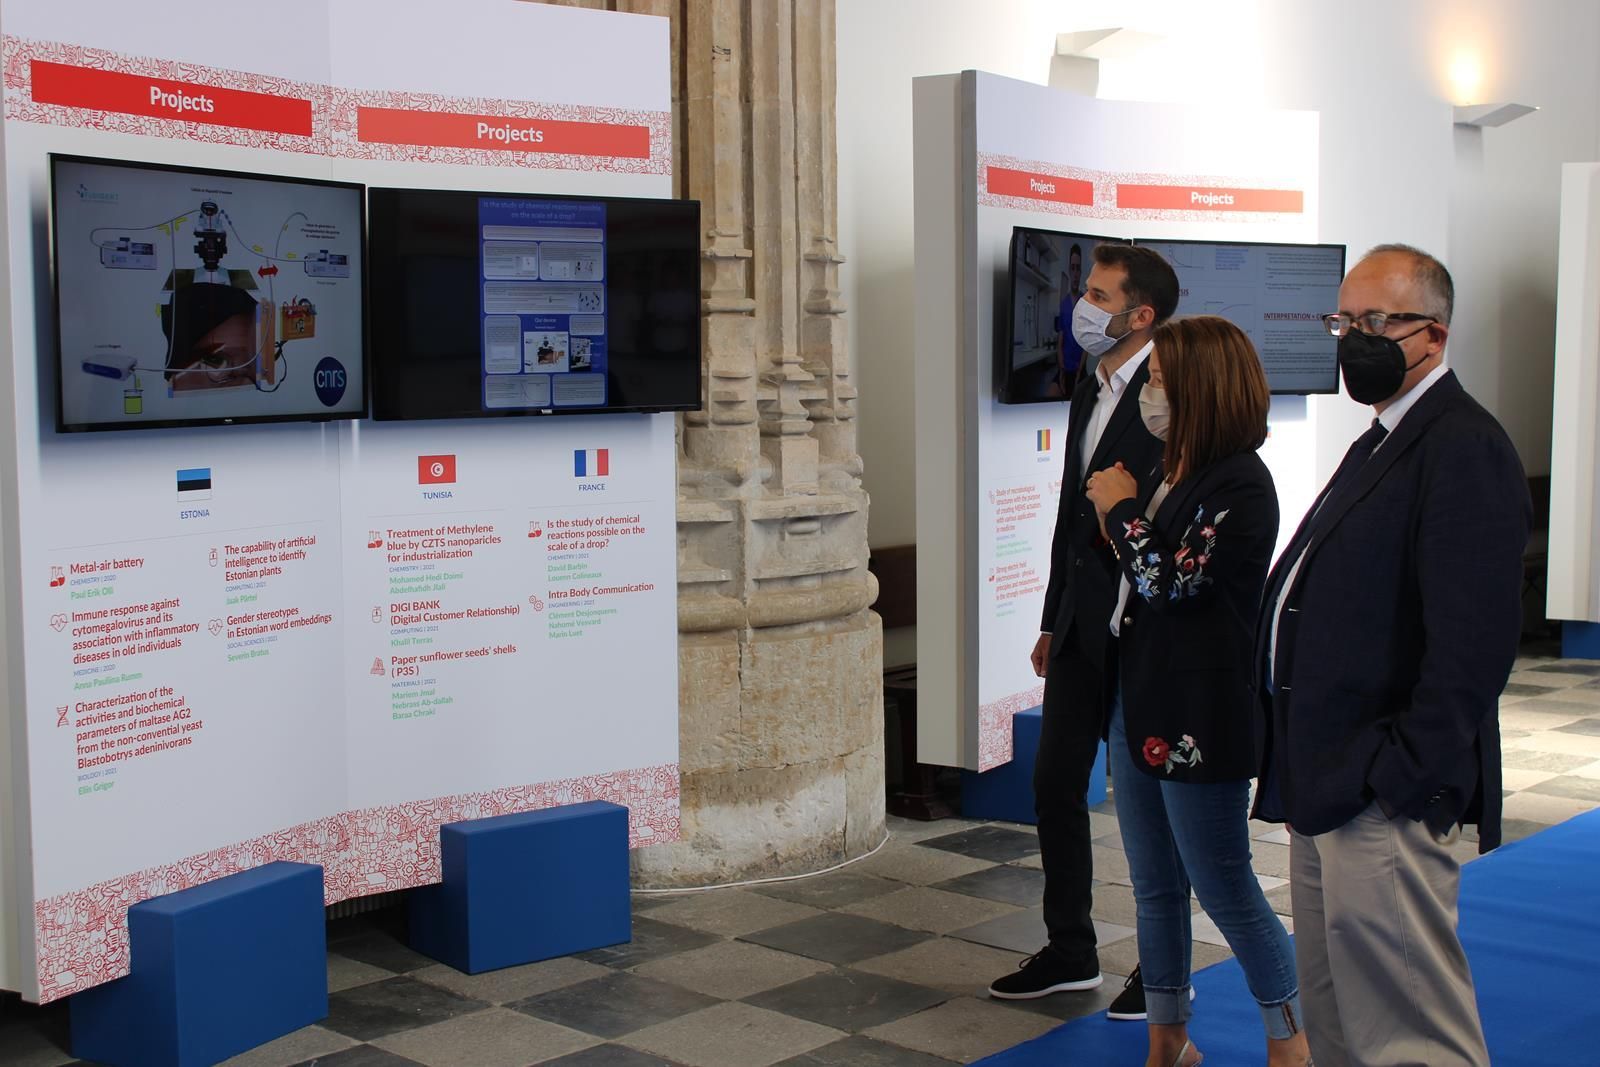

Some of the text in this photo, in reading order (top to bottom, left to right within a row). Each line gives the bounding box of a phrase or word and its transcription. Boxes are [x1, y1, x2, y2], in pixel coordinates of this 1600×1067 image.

[150, 86, 215, 114] Projects
[476, 121, 544, 146] Projects
[1030, 178, 1056, 196] Projects
[1191, 191, 1234, 206] Projects
[316, 369, 345, 389] cnrs
[423, 491, 453, 499] TUNISIA
[579, 483, 605, 491] FRANCE
[180, 509, 210, 519] ESTONIA
[547, 514, 640, 529] Is the study of chemical
[387, 524, 494, 538] Treatment of Methylene
[547, 530, 585, 540] reactions
[586, 527, 619, 538] possible
[632, 526, 645, 534] the
[225, 536, 316, 555] The capability of artificial
[387, 535, 501, 551] blue by CZTS nanoparicles
[547, 542, 568, 551] scale
[569, 541, 579, 549] of
[586, 539, 610, 549] drop?
[225, 549, 307, 569] intelligence to identify
[387, 549, 473, 563] for industrialization
[70, 558, 144, 574] Metal-air battery
[225, 566, 282, 581] Estonian plants
[548, 582, 654, 599] Intra Body Communication
[72, 598, 180, 622] Immune response against
[227, 607, 299, 625] Gender stereotypes
[390, 600, 440, 613] DIGI BANK
[390, 604, 520, 626] (Digital Customer Relationship)
[72, 613, 173, 637] cytomegalovirus and its
[227, 613, 332, 638] in Estonian word embeddings
[72, 622, 200, 651] association with inflammatory
[73, 637, 181, 664] diseases in old individuals
[392, 644, 517, 666] Paper sunflower seeds' shells
[76, 686, 174, 713] Characterization of the
[75, 696, 185, 728] activities and biochemical
[76, 708, 191, 743] parameters of maltase AG2
[77, 720, 203, 755] from the non-convential yeast
[77, 736, 192, 769] Blastobotrys adeninivorans
